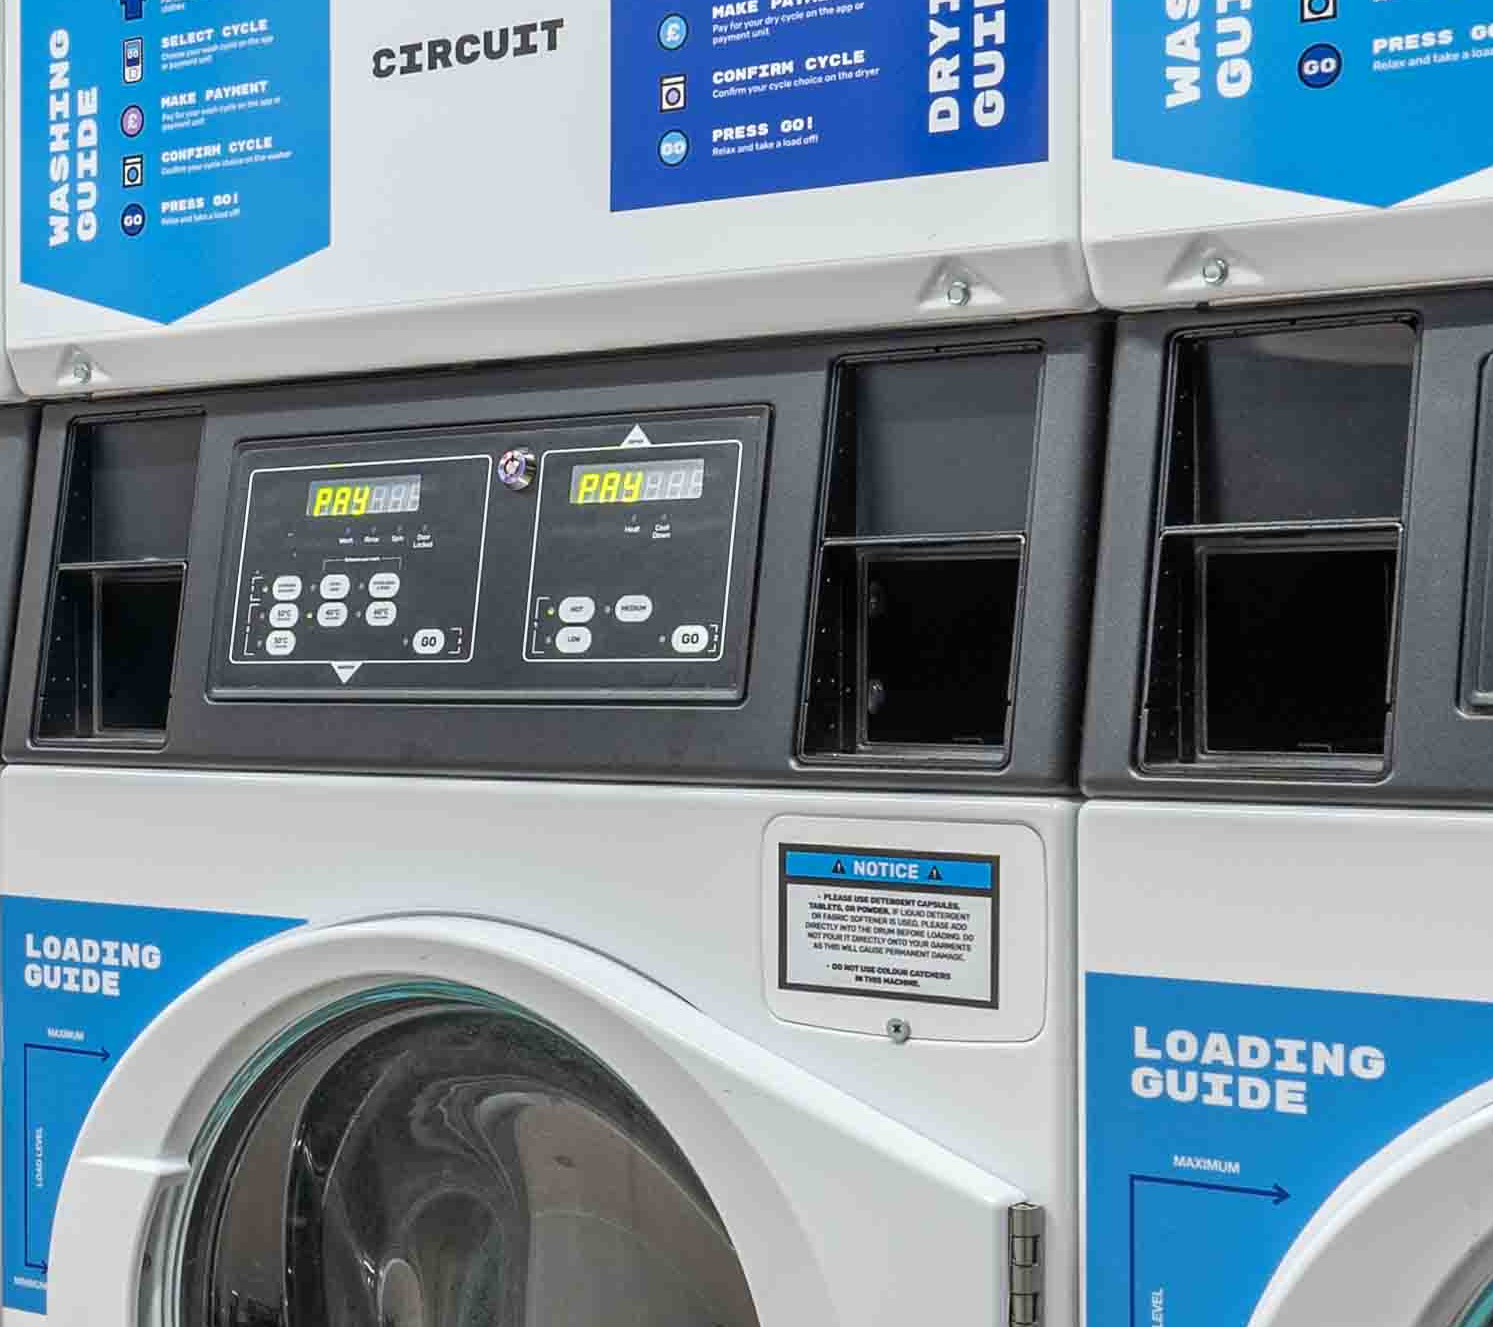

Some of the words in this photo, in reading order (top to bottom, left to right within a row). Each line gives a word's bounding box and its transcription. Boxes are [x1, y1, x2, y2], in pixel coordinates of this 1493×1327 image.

[712, 0, 759, 19] MAKE
[161, 28, 214, 49] SELECT
[221, 18, 268, 38] CYCLE
[372, 17, 564, 79] CIRCUIT
[1372, 29, 1453, 55] PRESS
[712, 60, 794, 85] CONFIRM
[805, 49, 865, 71] CYCLE
[1303, 56, 1336, 76] GO
[161, 92, 196, 108] MAKE
[205, 81, 268, 101] PAYMENT
[49, 29, 70, 247] WASHING
[712, 122, 769, 143] PRESS
[780, 116, 813, 133] GO!
[77, 86, 98, 241] GUIDE
[161, 143, 221, 163] CONFIRM
[228, 136, 273, 153] CYCLE
[161, 197, 205, 213] PRESS
[213, 193, 238, 207] GO!
[124, 215, 142, 227] GO
[313, 485, 370, 518] PAY
[578, 470, 643, 504] PAY
[853, 860, 919, 880] NOTICE
[26, 933, 161, 970] LOADING
[24, 963, 120, 997] GUIDE
[1134, 1025, 1385, 1080] LOADING
[1131, 1066, 1307, 1115] GUIDE
[1173, 1155, 1240, 1174] MAXIMUM
[1152, 1287, 1165, 1326] LEVEL
